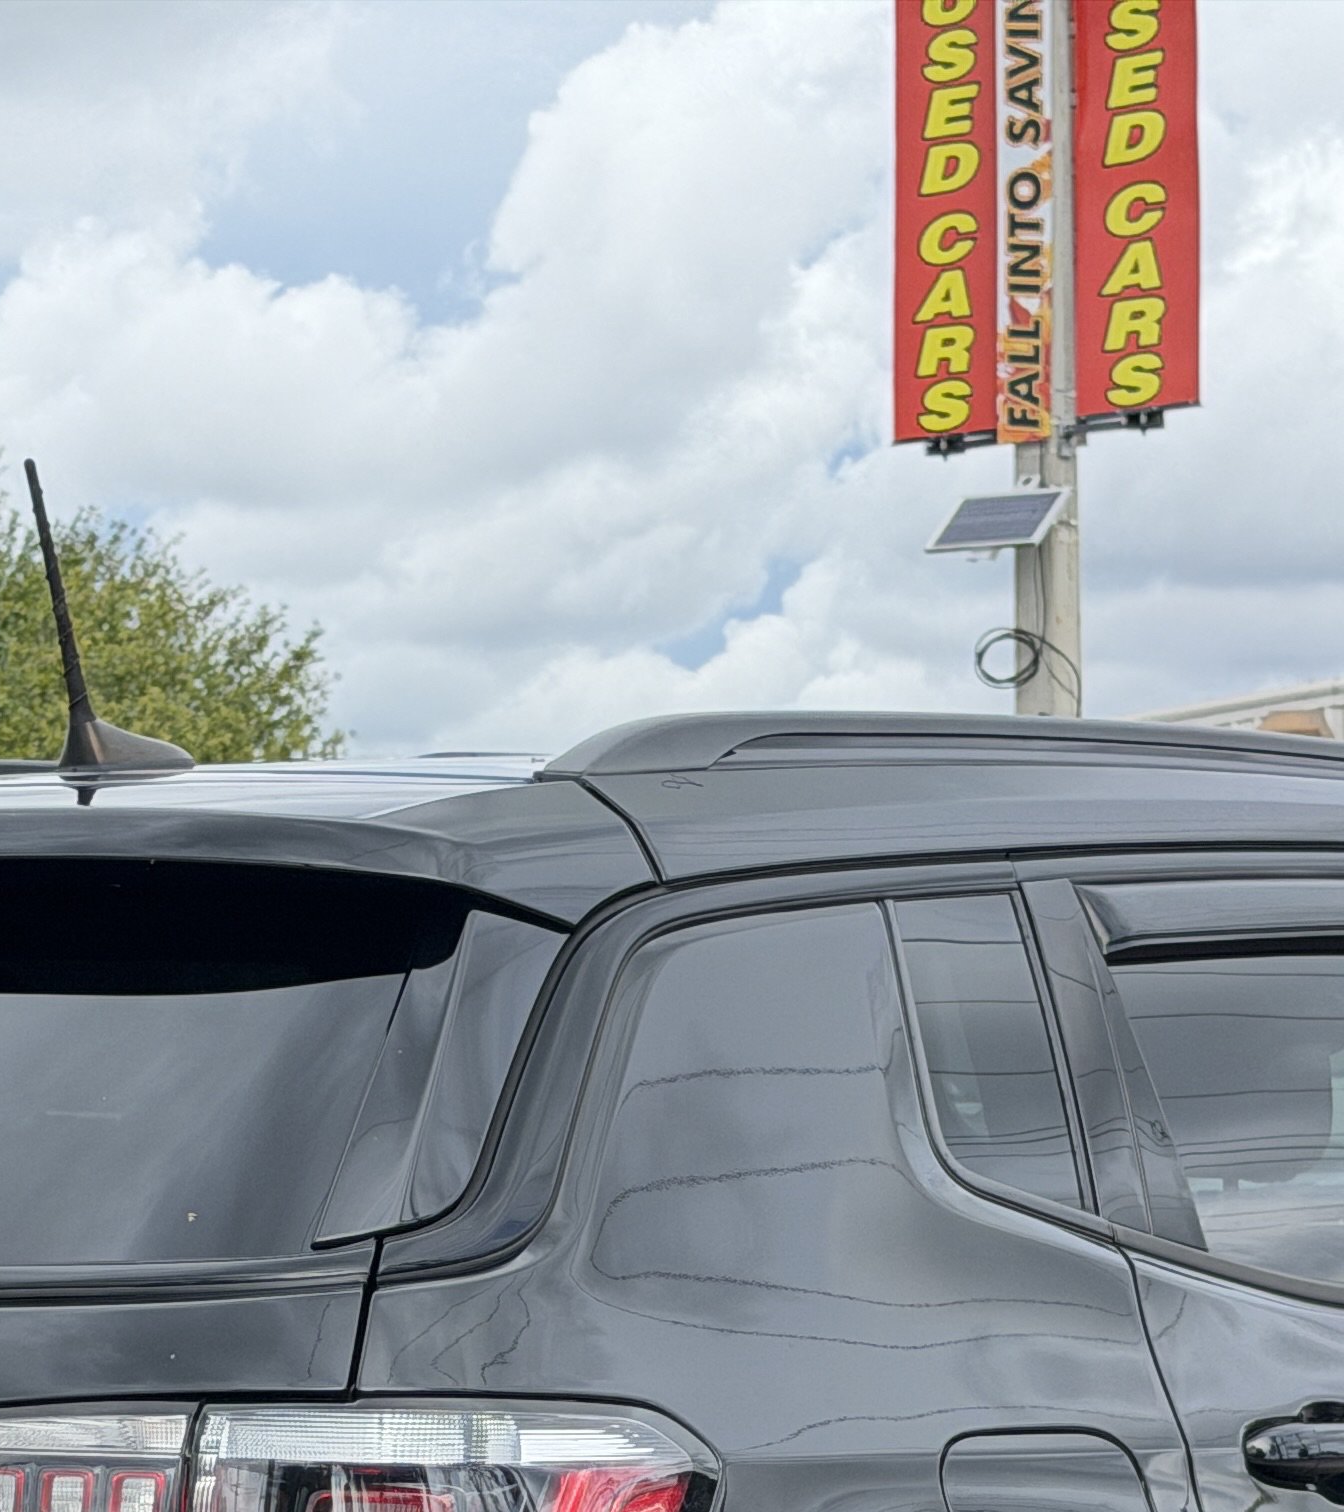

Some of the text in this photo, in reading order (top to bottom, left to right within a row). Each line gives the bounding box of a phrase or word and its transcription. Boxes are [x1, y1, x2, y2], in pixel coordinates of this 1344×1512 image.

[1007, 171, 1043, 295] INTO
[1099, 181, 1167, 408] CARS
[913, 210, 979, 434] CARS
[1007, 317, 1043, 430] FALL
